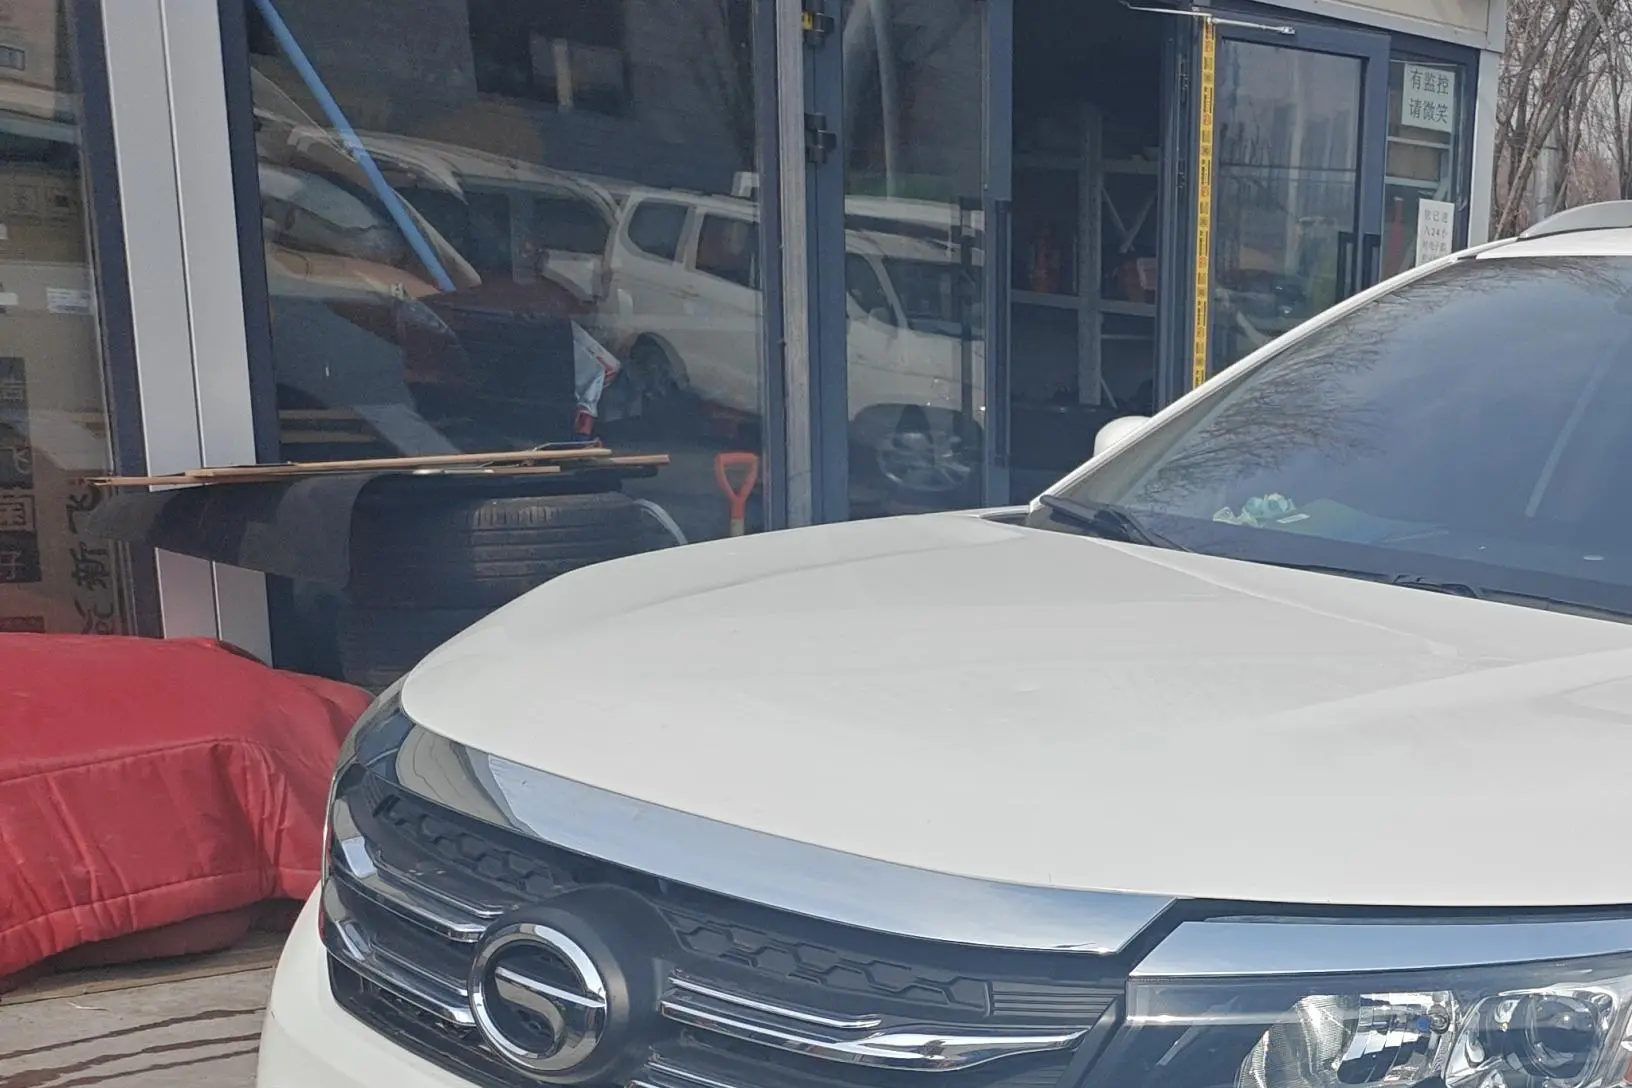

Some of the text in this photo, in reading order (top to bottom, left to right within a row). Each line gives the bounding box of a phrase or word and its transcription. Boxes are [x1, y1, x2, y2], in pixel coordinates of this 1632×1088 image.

[1409, 68, 1449, 95] 有监控
[1408, 97, 1448, 124] 请微笑
